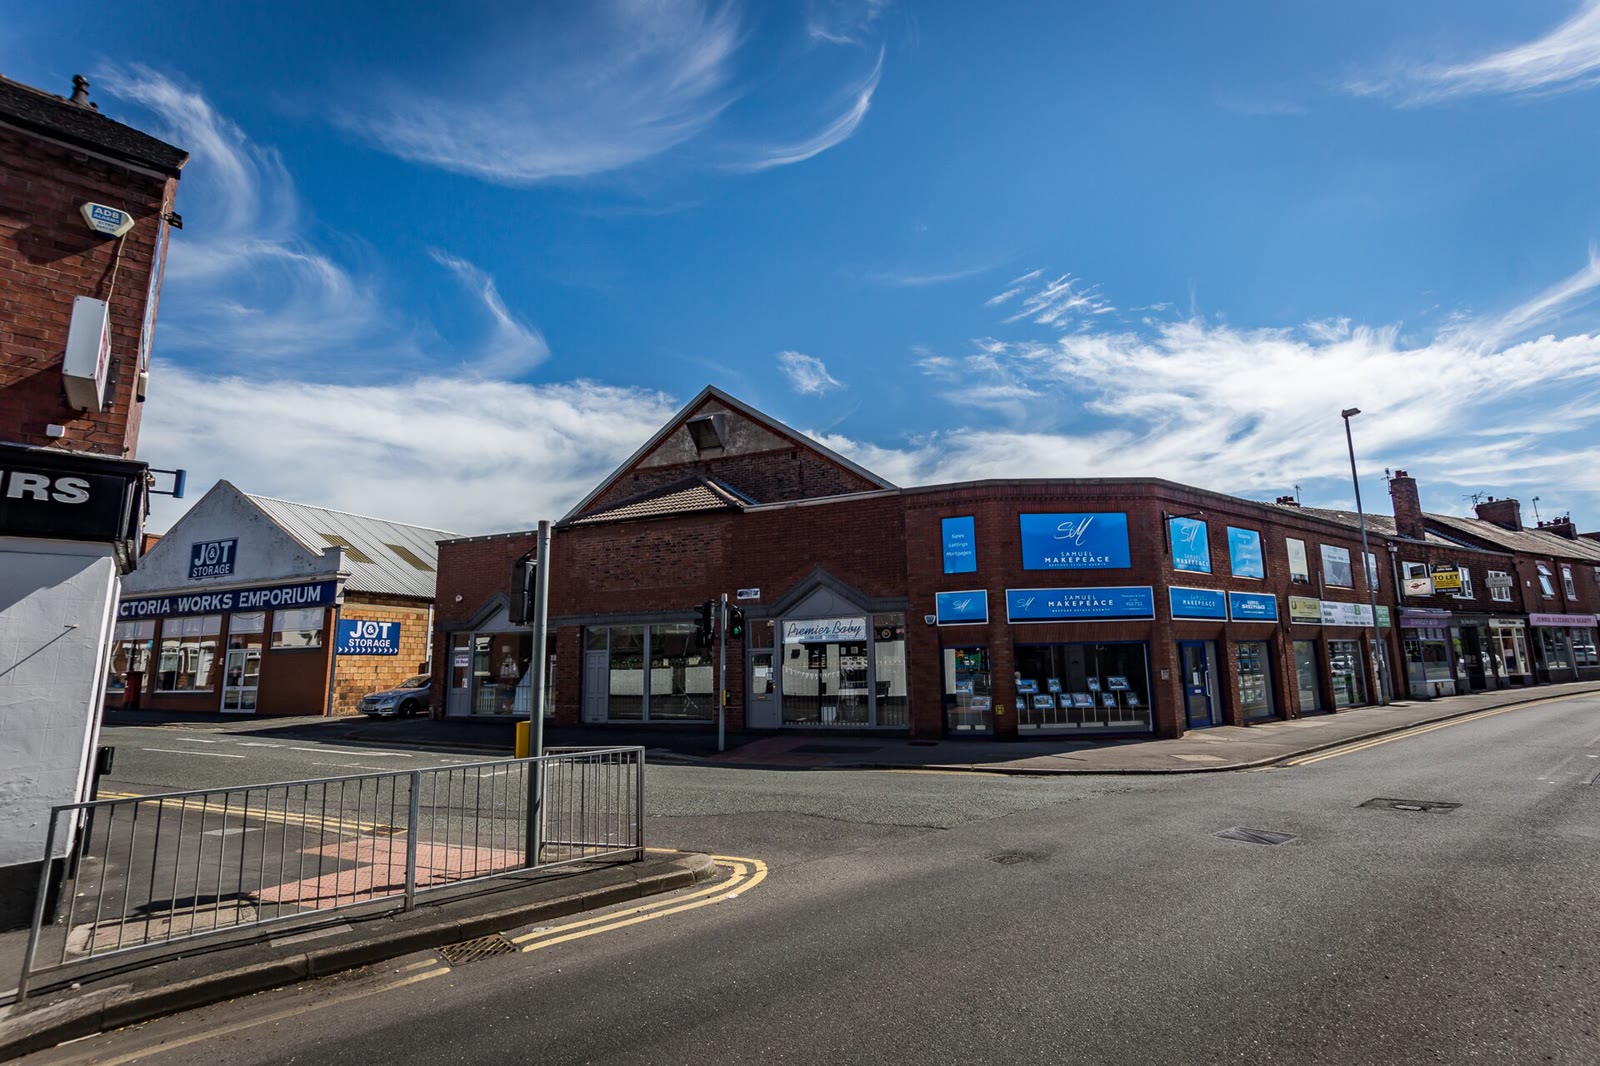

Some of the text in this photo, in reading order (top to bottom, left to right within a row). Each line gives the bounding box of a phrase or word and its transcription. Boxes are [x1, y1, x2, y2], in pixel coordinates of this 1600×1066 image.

[95, 207, 120, 219] ADB
[0, 470, 91, 504] RS
[194, 541, 233, 566] J&T
[192, 564, 231, 577] STORAGE
[118, 585, 321, 616] CTORIA WORKS EMPORIUM
[1048, 599, 1114, 607] MAKEPEACE
[1182, 599, 1216, 607] MAKEPEACE
[350, 621, 392, 639] J&T
[788, 623, 830, 636] Premier
[832, 620, 862, 637] Baby
[348, 638, 391, 647] STORAGE
